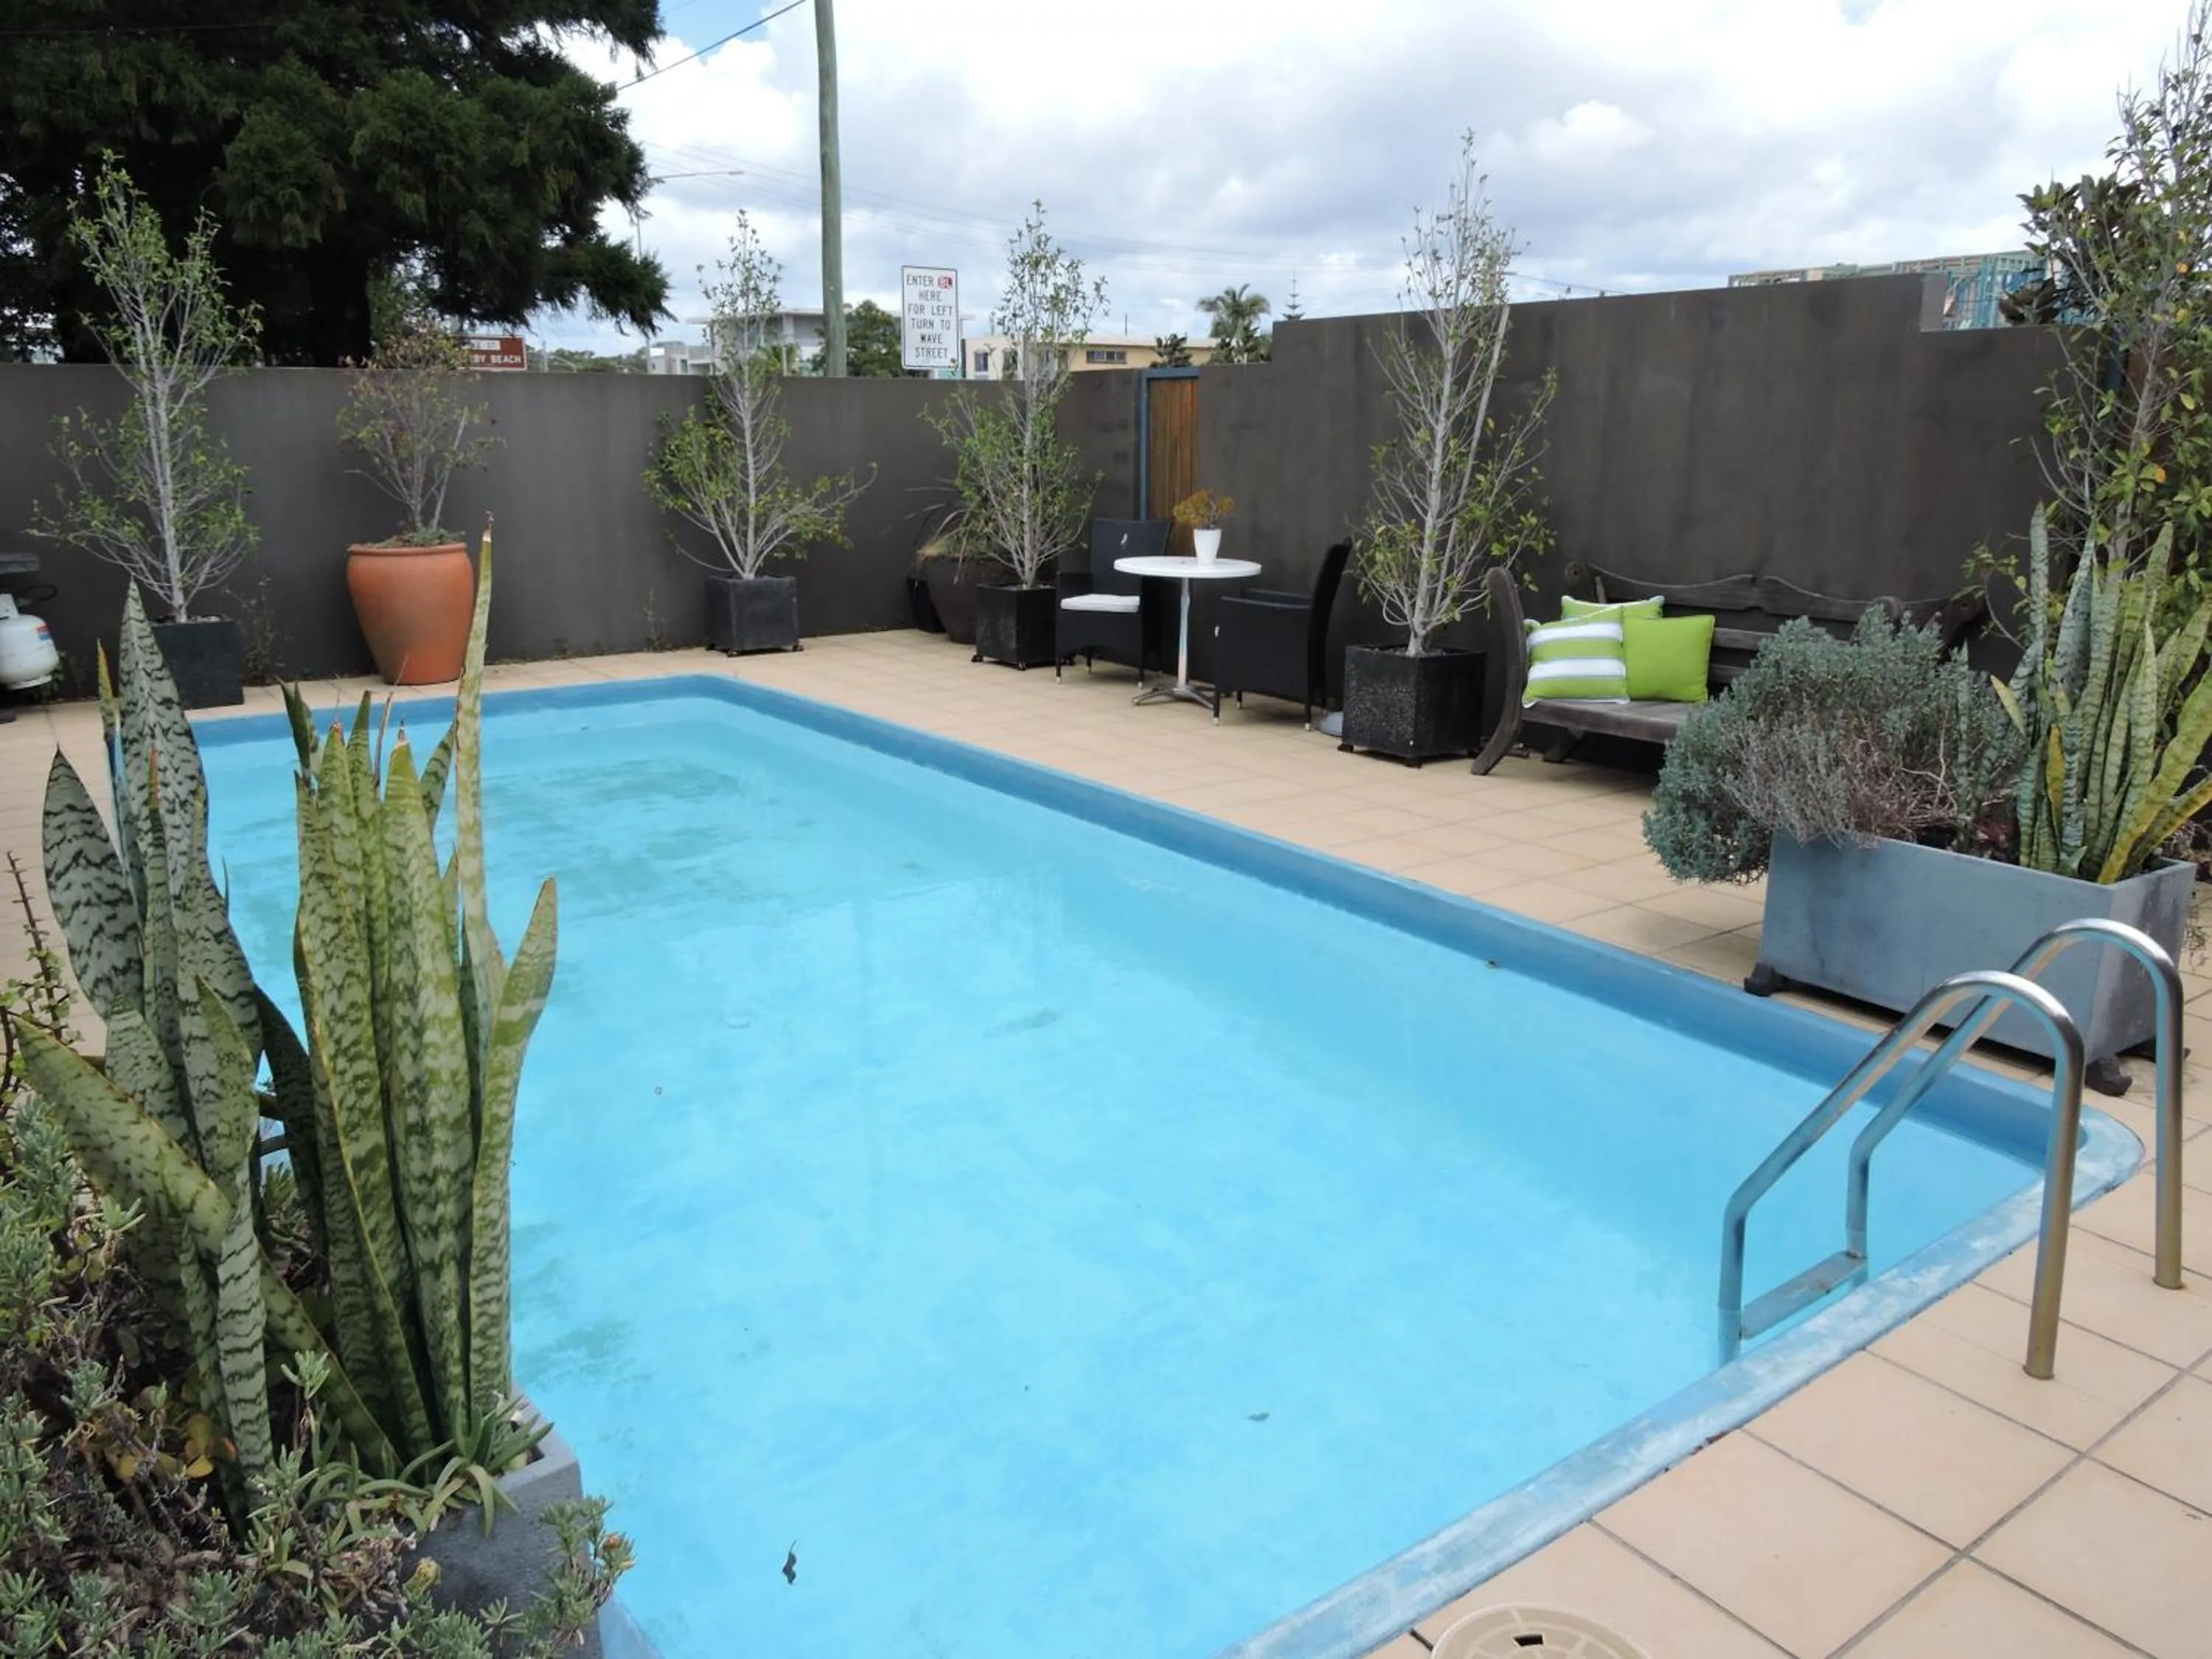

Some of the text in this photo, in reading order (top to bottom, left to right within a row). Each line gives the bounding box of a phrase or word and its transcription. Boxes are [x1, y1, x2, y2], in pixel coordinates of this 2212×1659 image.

[906, 274, 933, 288] ENTER
[919, 291, 943, 302] HERE
[908, 303, 953, 316] FOR LEFT
[911, 318, 951, 330] TURN TO
[920, 333, 942, 344] WAVE
[914, 347, 948, 359] STREET
[490, 355, 521, 364] BEACH
